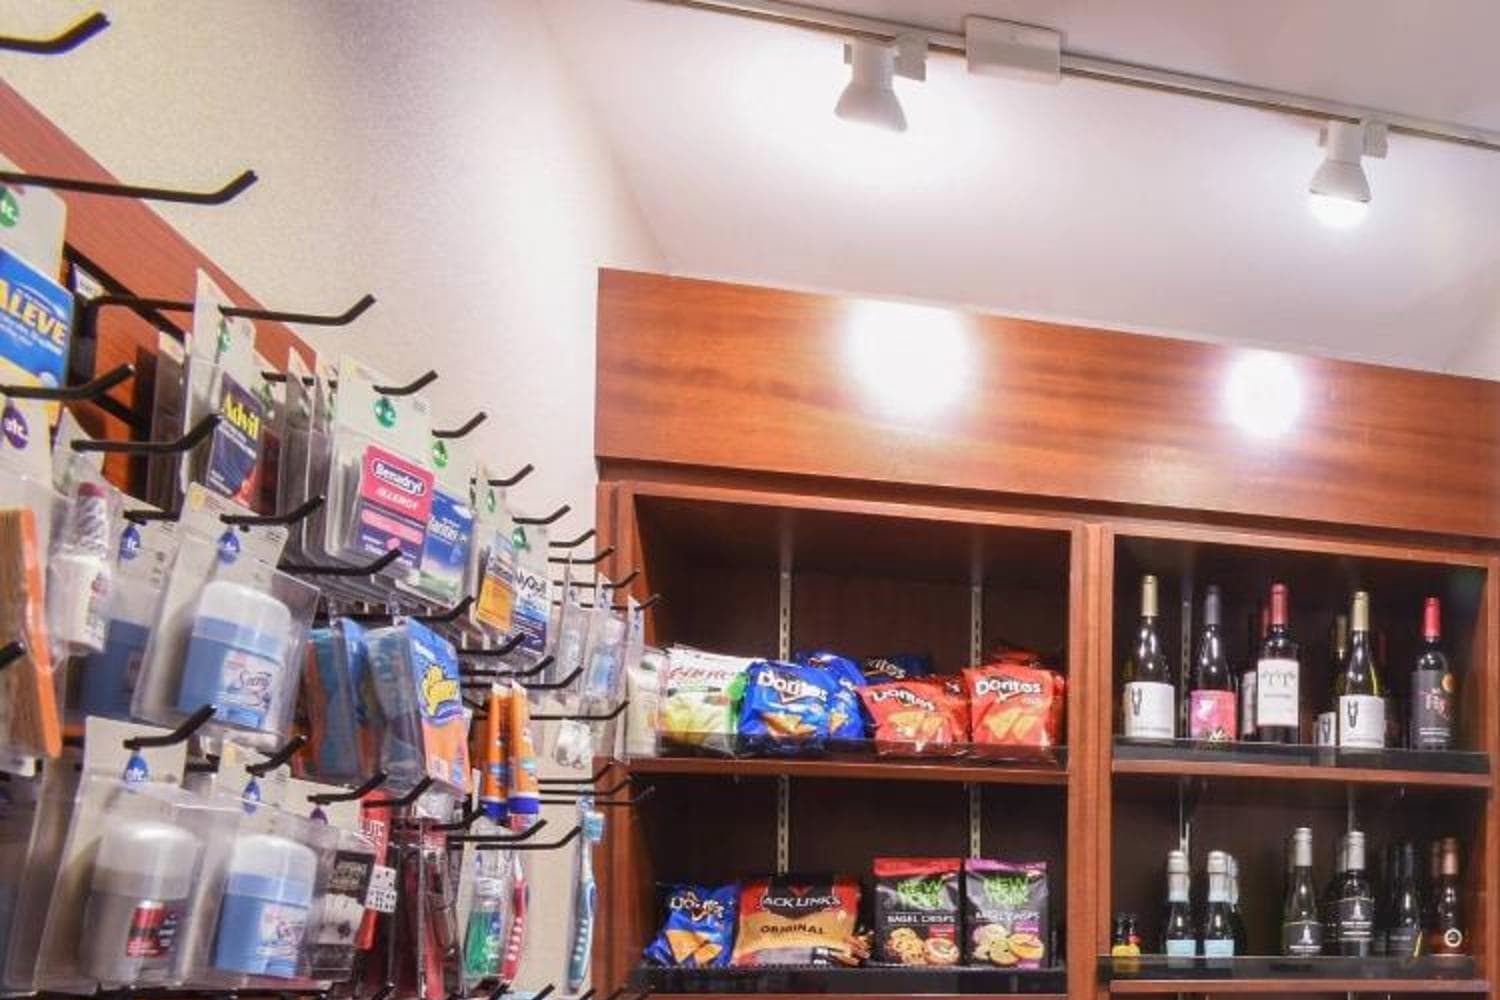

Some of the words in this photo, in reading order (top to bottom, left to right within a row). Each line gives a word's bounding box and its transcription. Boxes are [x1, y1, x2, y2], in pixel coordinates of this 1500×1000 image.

[374, 462, 424, 495] Benadryl
[758, 669, 828, 703] Doritos
[976, 679, 1041, 700] Doritos
[760, 923, 824, 936] ORIGINAL
